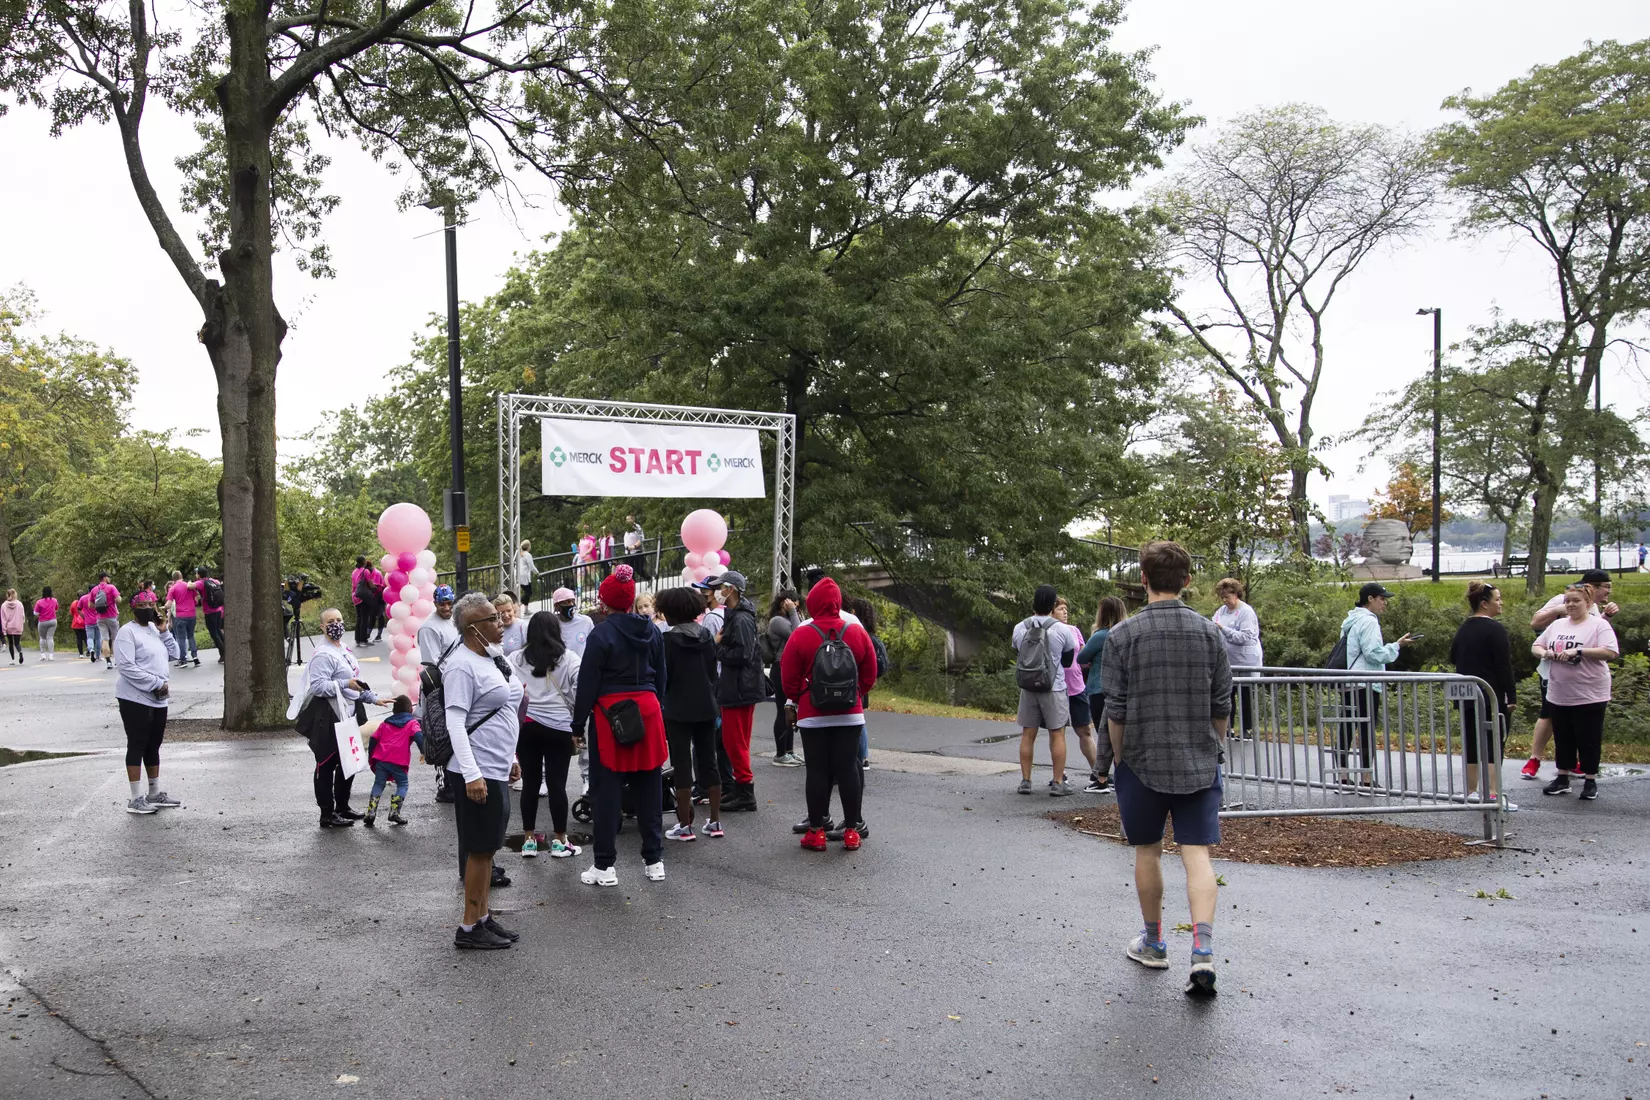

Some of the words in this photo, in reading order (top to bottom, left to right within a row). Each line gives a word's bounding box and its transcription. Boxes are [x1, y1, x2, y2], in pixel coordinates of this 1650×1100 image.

[569, 452, 603, 464] MERCK
[609, 446, 702, 475] START
[723, 458, 756, 469] MERCK
